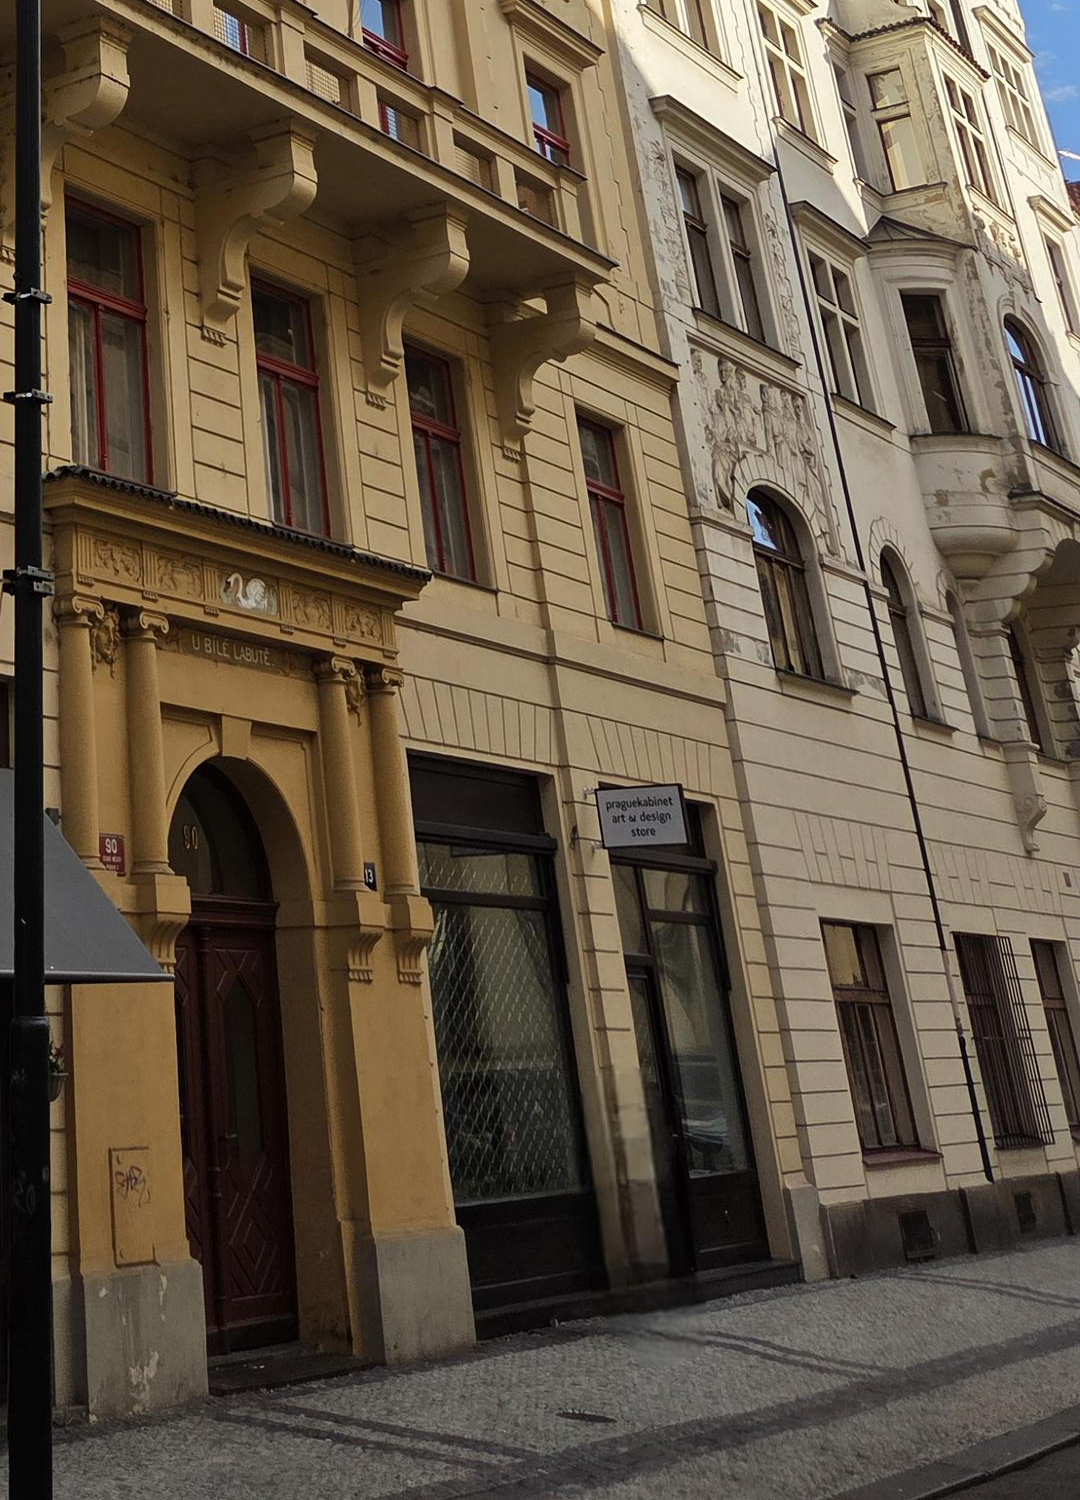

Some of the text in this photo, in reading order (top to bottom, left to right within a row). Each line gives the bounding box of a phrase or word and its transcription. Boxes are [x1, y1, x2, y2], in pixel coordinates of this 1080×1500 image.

[192, 634, 200, 651] U
[605, 795, 674, 813] praguekabinet
[611, 813, 627, 824] art
[639, 810, 672, 825] design
[630, 826, 657, 837] store
[105, 838, 118, 854] 90
[365, 868, 374, 883] 13
